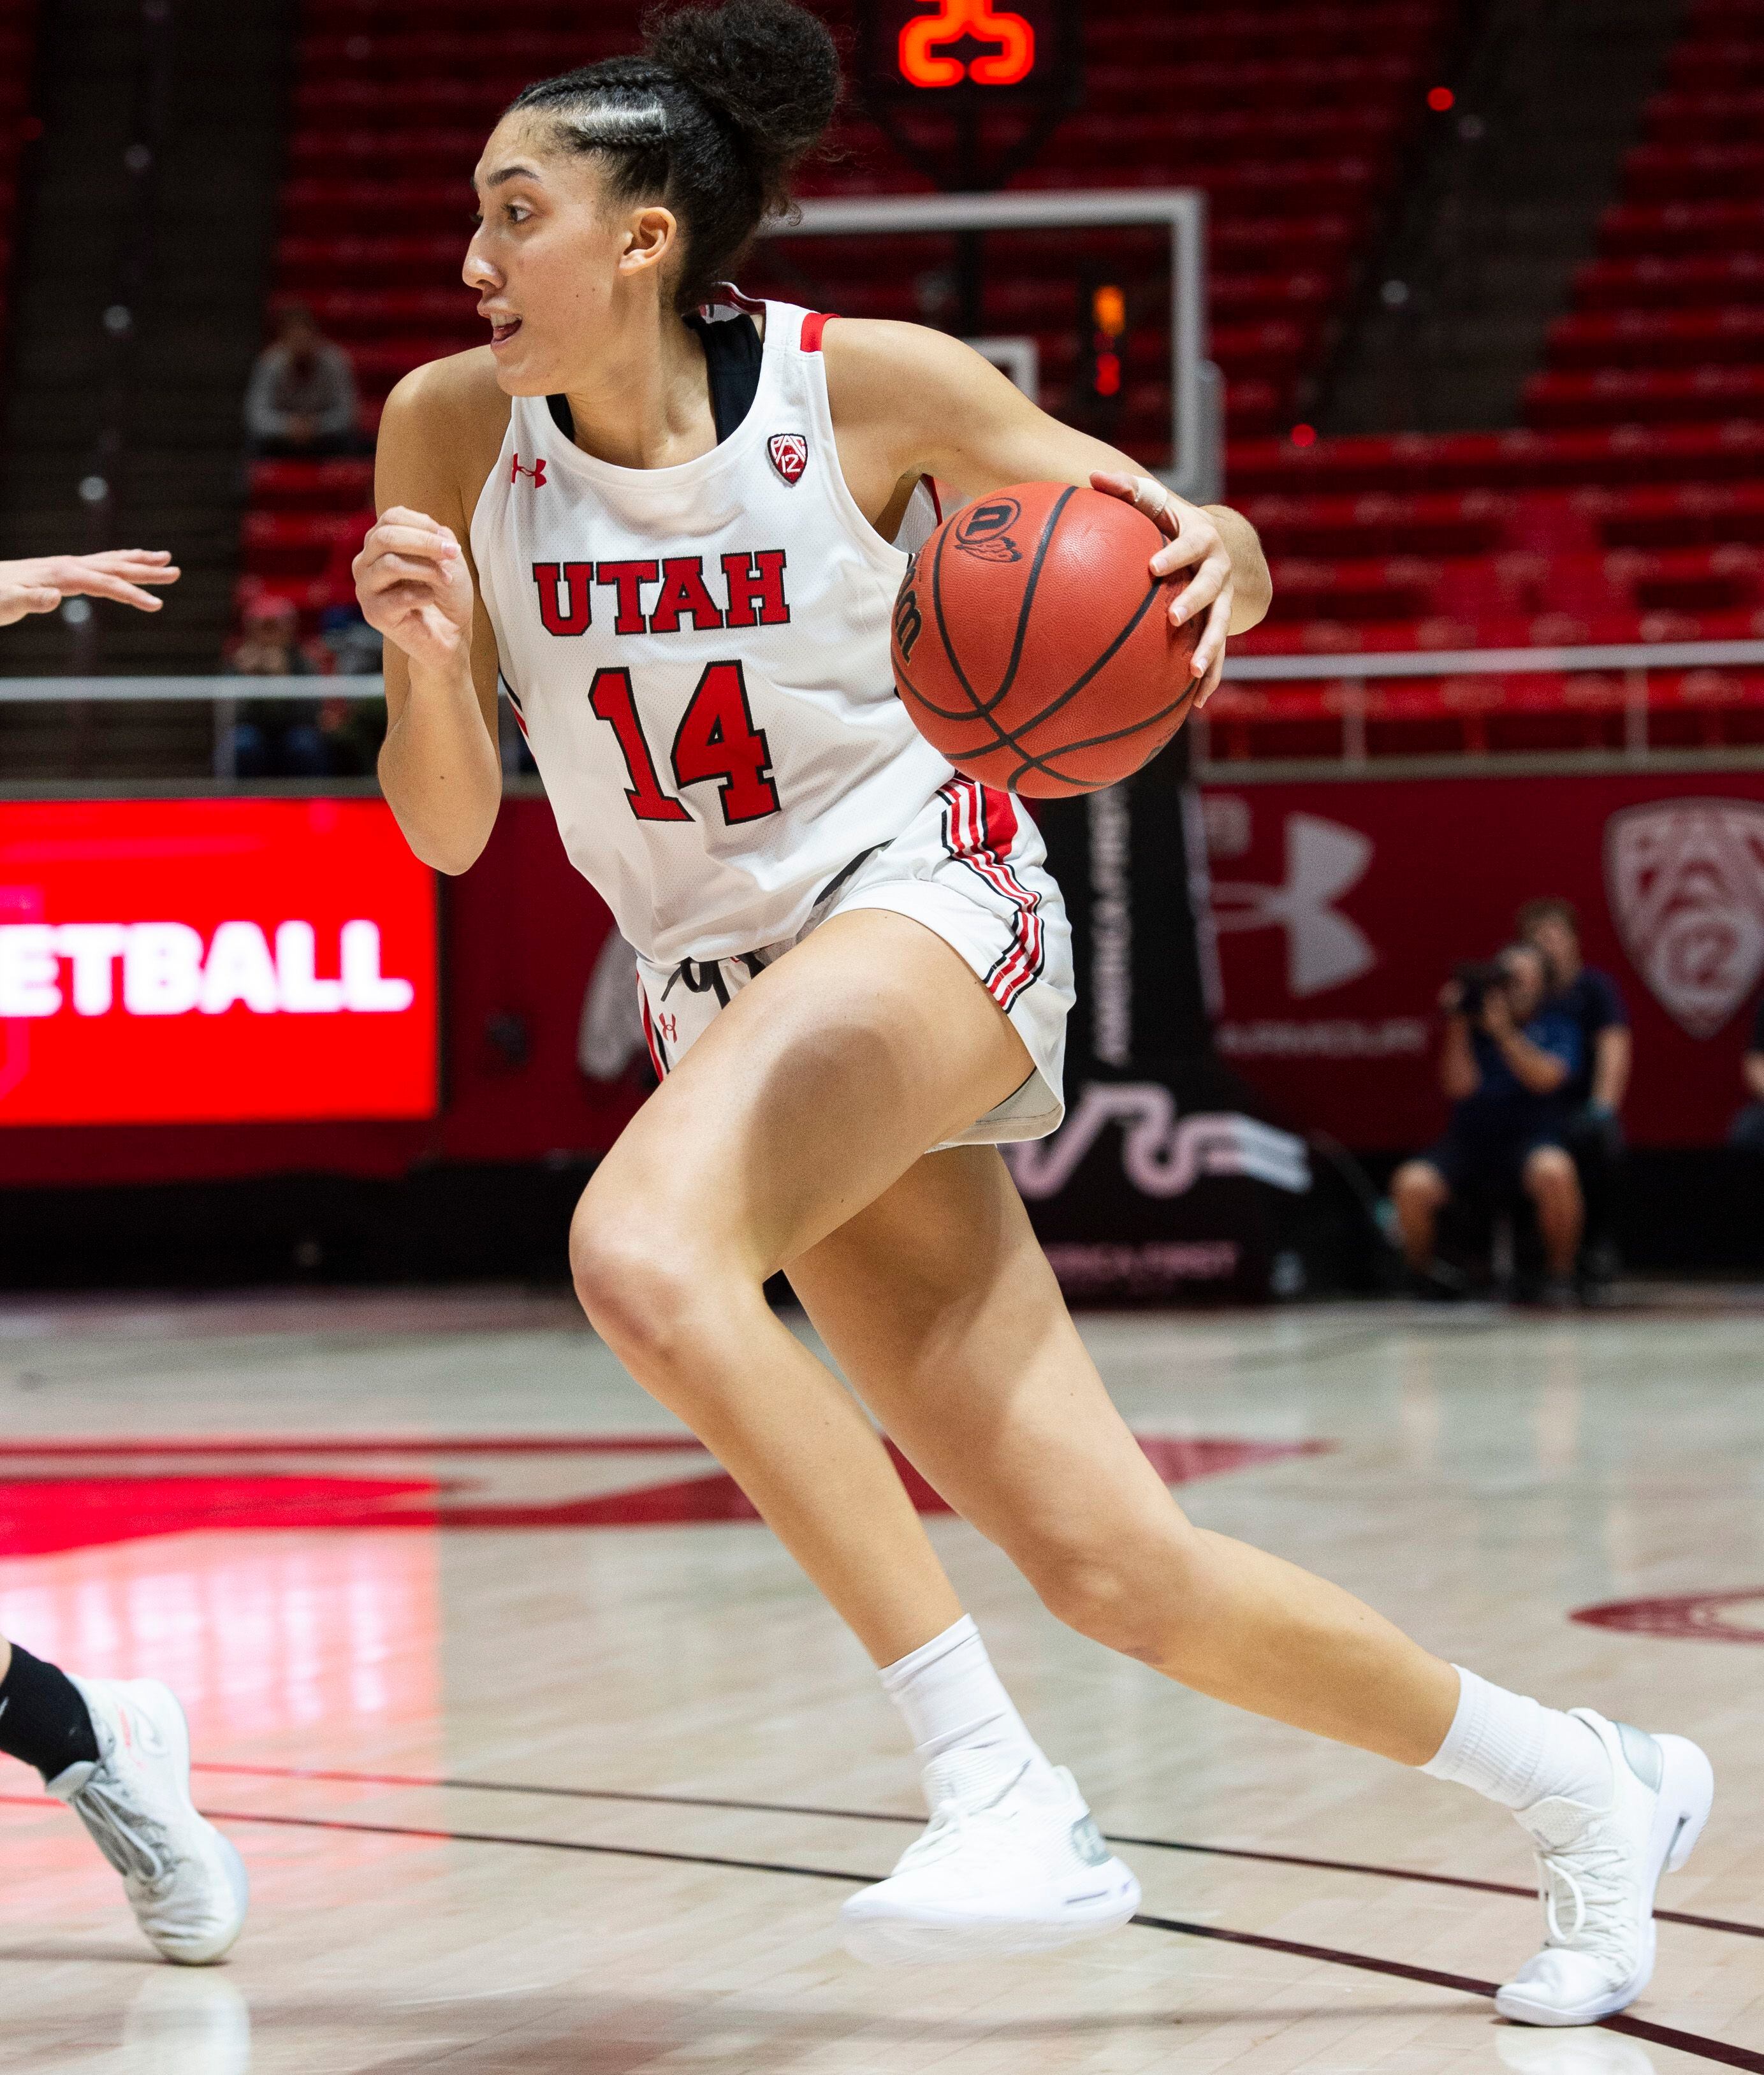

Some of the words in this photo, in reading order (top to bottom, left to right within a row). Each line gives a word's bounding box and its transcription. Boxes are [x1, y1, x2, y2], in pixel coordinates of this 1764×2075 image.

[770, 435, 806, 464] PAC
[781, 454, 801, 473] 12
[532, 549, 791, 636] UTAH
[588, 659, 782, 826] 14
[0, 919, 414, 1017] ETBALL
